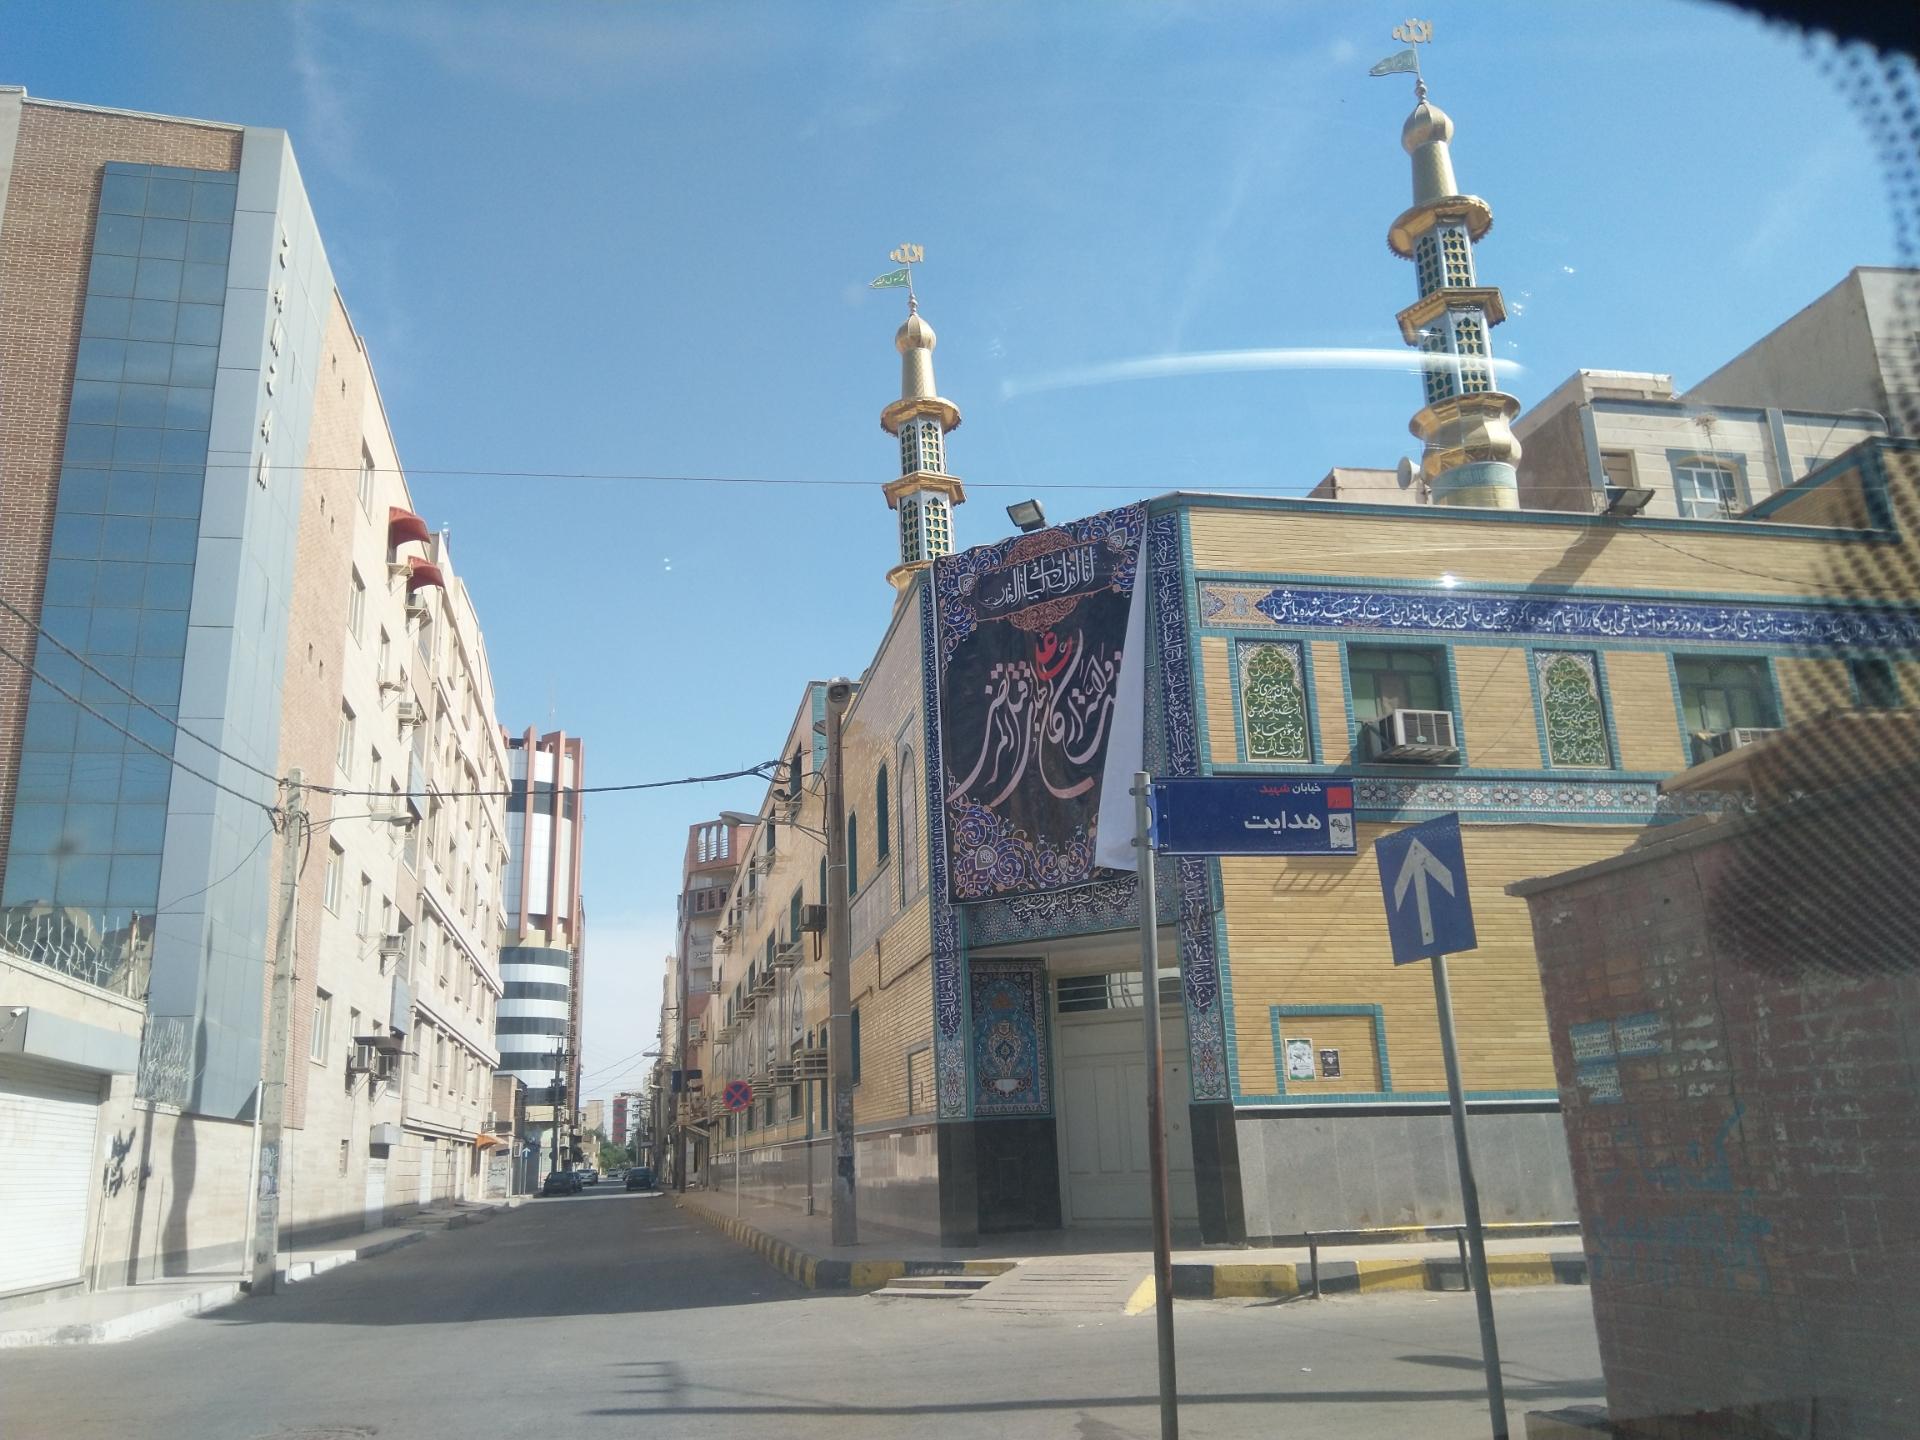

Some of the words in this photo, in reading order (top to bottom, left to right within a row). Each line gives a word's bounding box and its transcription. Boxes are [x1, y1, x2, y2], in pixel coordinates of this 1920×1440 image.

[1273, 590, 1299, 622] باشی
[1367, 601, 1395, 619] است
[1614, 604, 1639, 636] باشی
[1638, 608, 1660, 631] داشته
[1737, 609, 1759, 639] باشی
[1758, 612, 1778, 634] داشته
[1260, 784, 1290, 795] شهید
[1292, 782, 1321, 795] خیابان
[1244, 810, 1321, 835] هدایت
